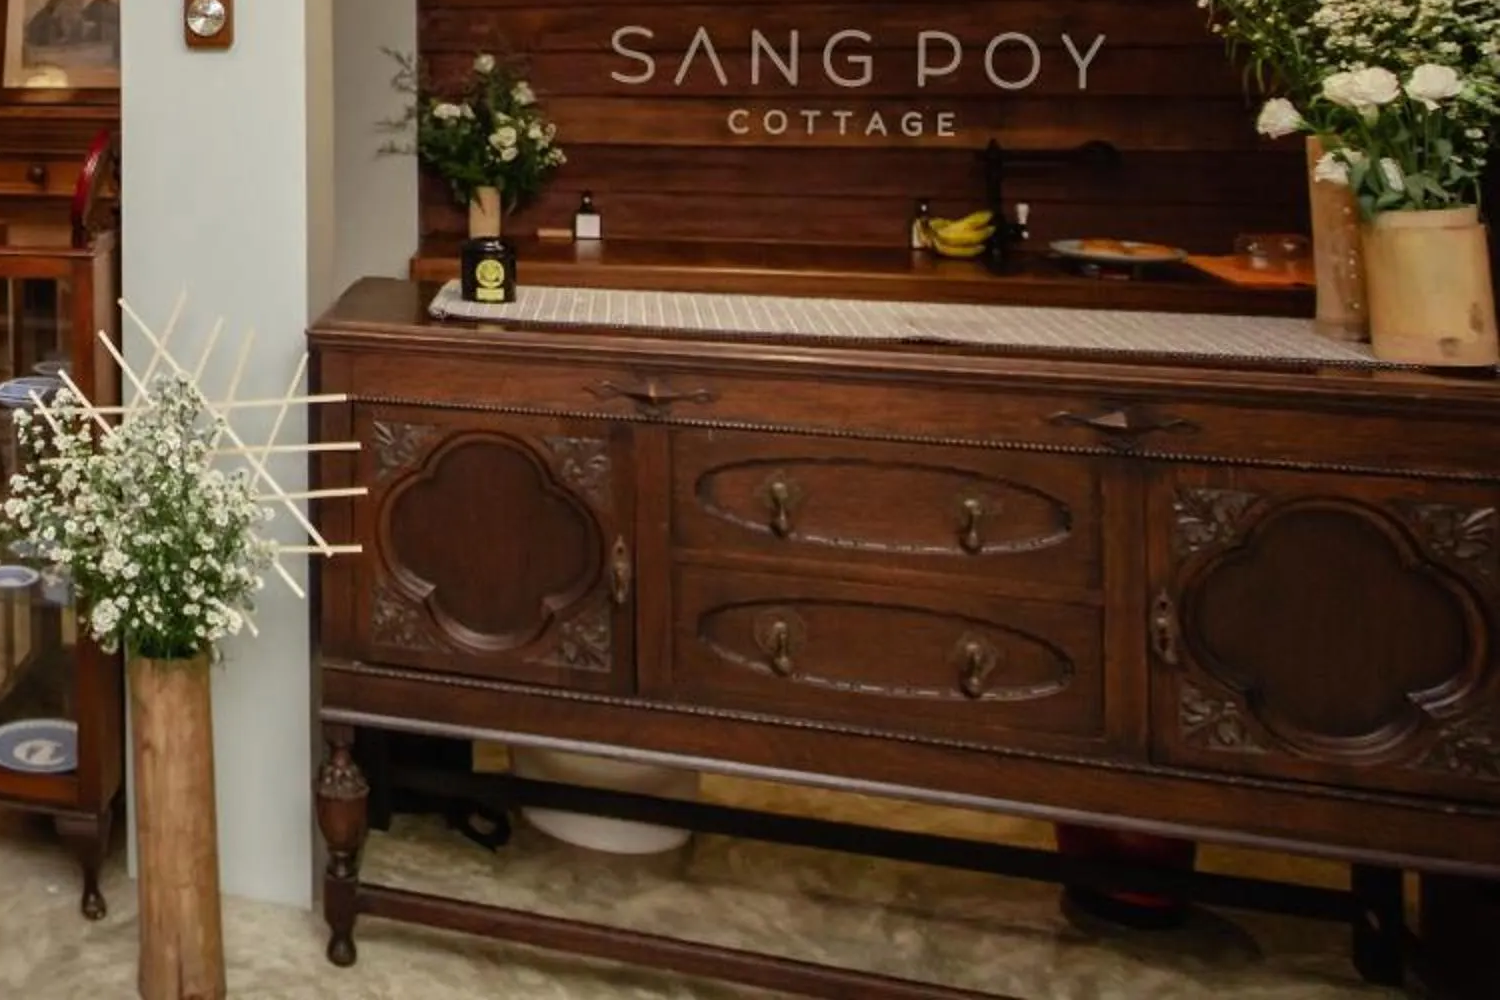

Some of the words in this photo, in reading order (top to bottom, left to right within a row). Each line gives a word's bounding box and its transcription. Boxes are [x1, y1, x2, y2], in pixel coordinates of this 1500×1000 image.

[611, 25, 874, 87] SANG
[917, 31, 1106, 90] POY
[727, 109, 956, 137] COTTAGE
